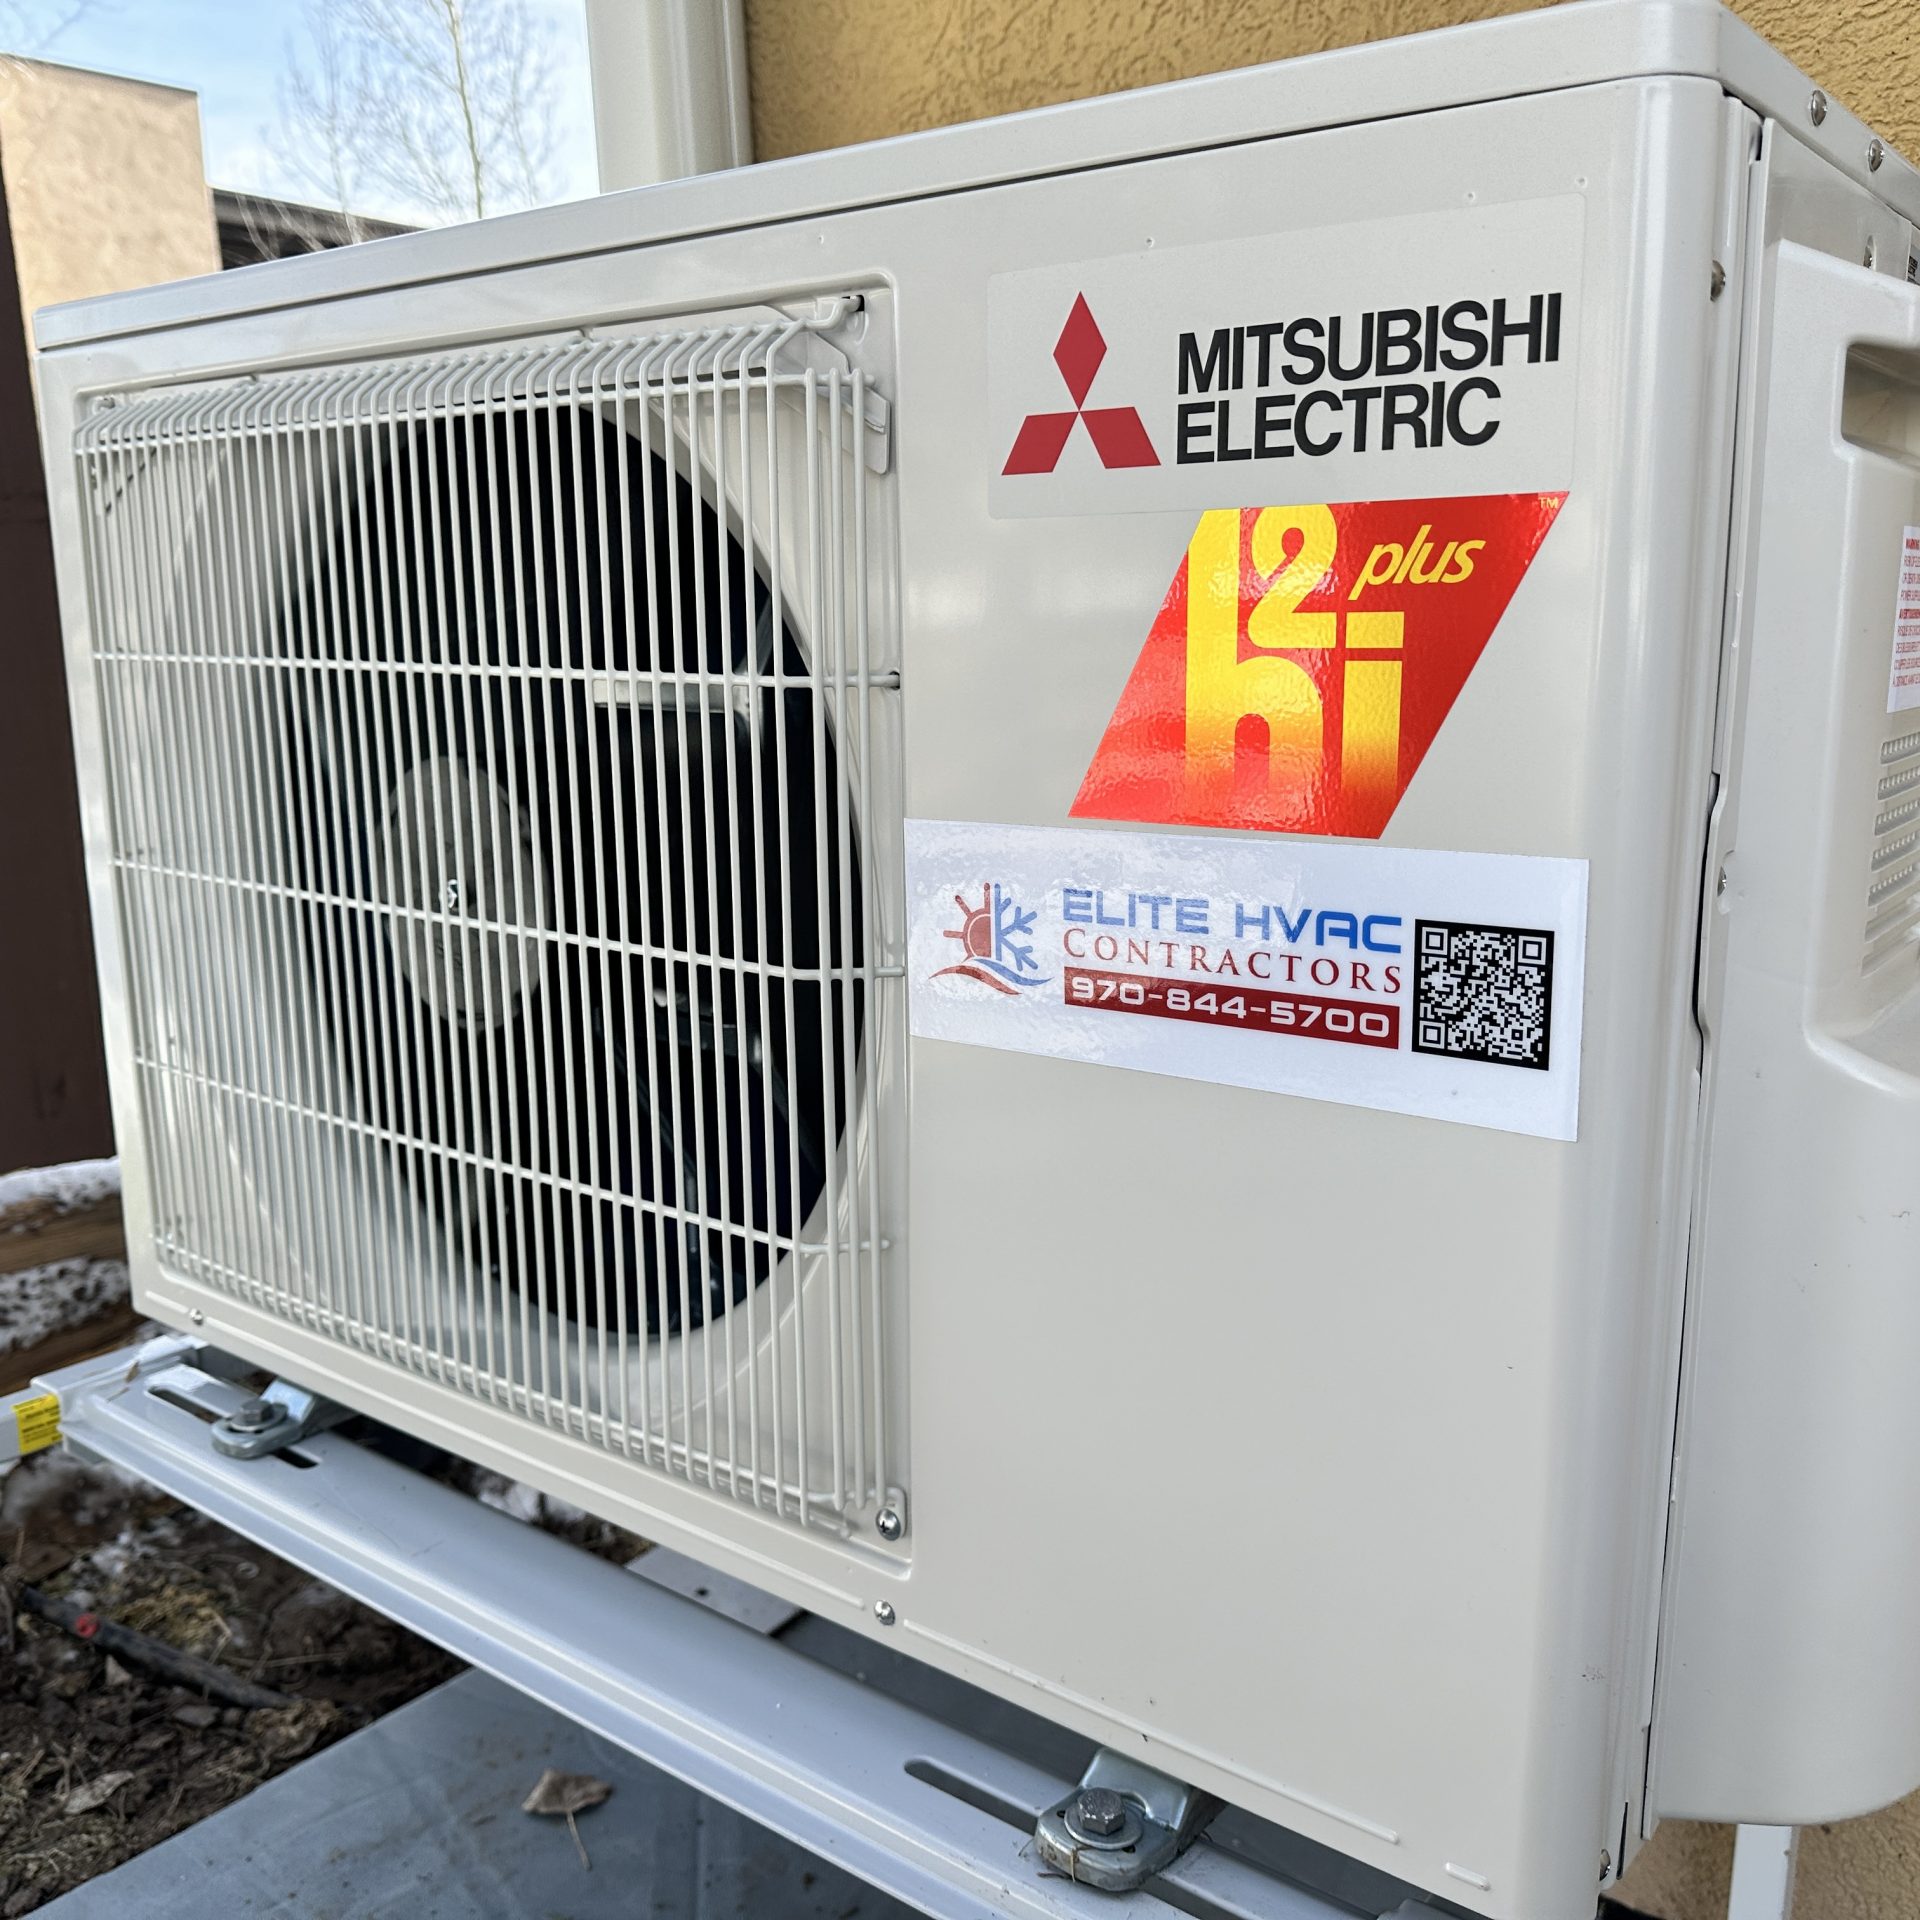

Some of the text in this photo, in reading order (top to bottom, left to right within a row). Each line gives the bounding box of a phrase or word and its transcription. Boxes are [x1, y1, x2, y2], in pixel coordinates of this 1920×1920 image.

[1178, 292, 1562, 395] MITSUBISHI
[1176, 376, 1501, 465] ELECTRIC
[1347, 524, 1487, 601] plus
[1063, 888, 1402, 954] ELITE HVAC
[1063, 927, 1401, 994] CONTRACTORS
[1071, 976, 1390, 1038] 970-844-5700
